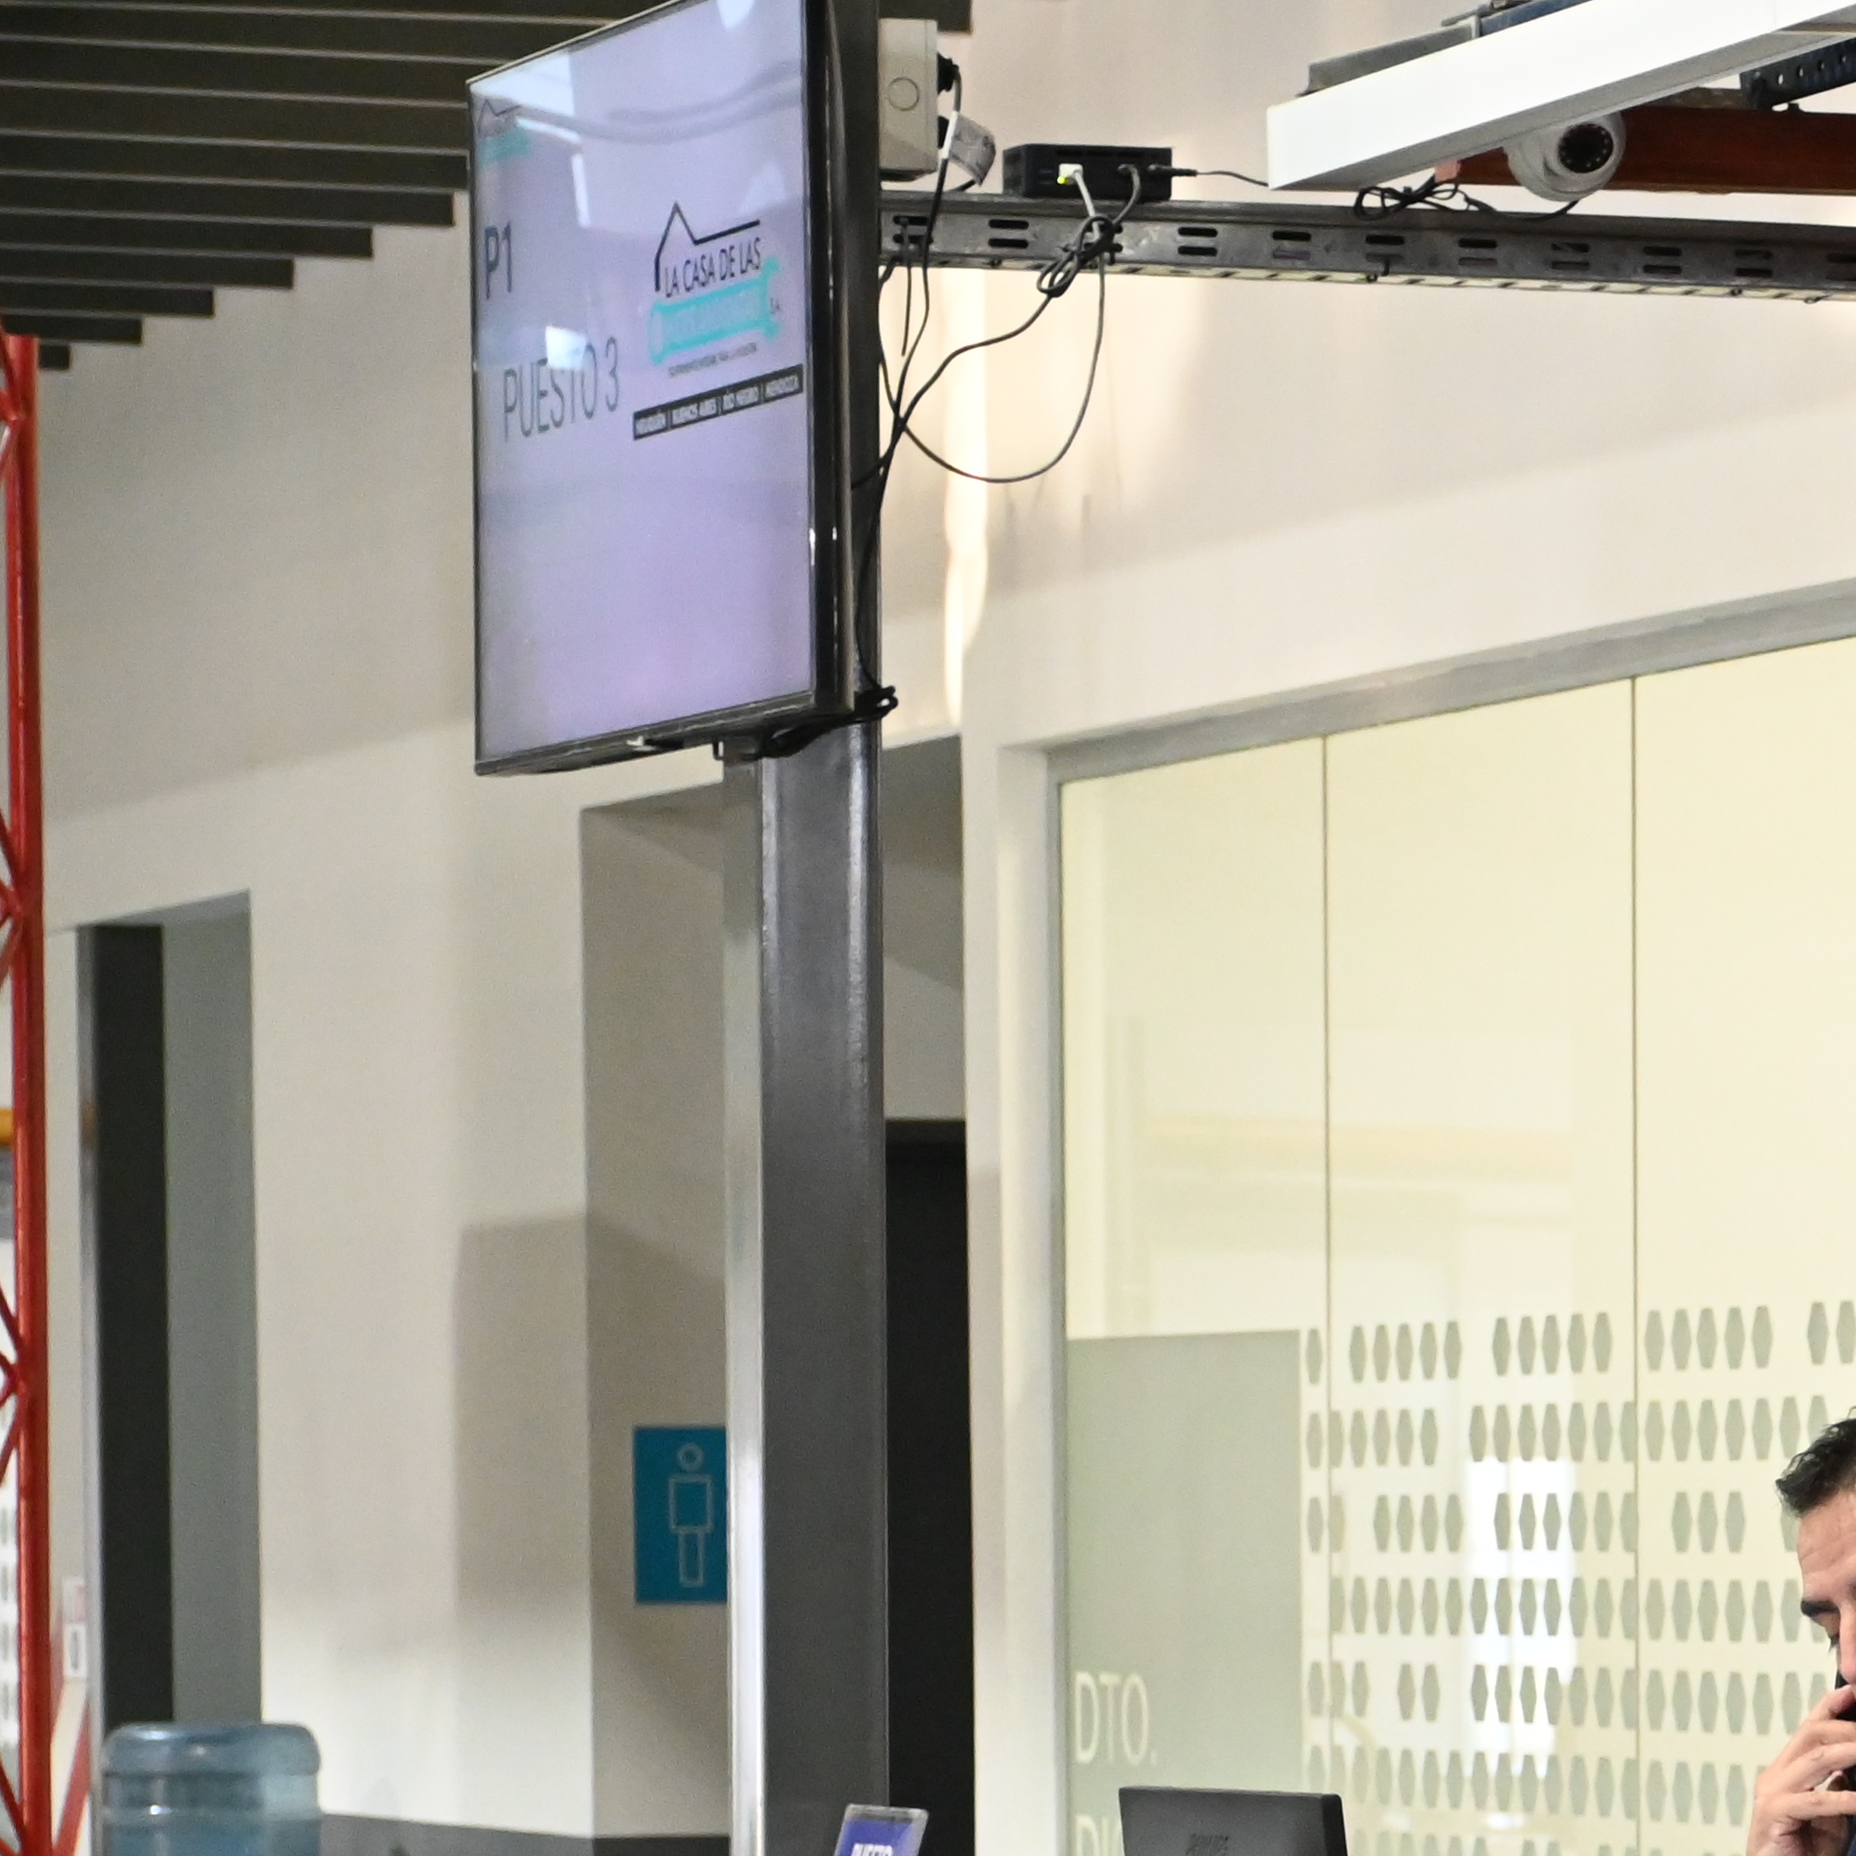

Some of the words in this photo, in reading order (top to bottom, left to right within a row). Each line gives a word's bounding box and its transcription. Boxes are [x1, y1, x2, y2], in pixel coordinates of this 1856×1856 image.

[484, 222, 512, 299] P1
[664, 265, 680, 298] LA
[682, 253, 716, 292] CASA
[718, 245, 736, 281] DE
[739, 236, 762, 275] LAS
[504, 343, 598, 443] PUESTO
[604, 336, 620, 412] 3
[1074, 1671, 1157, 1767] DTO.
